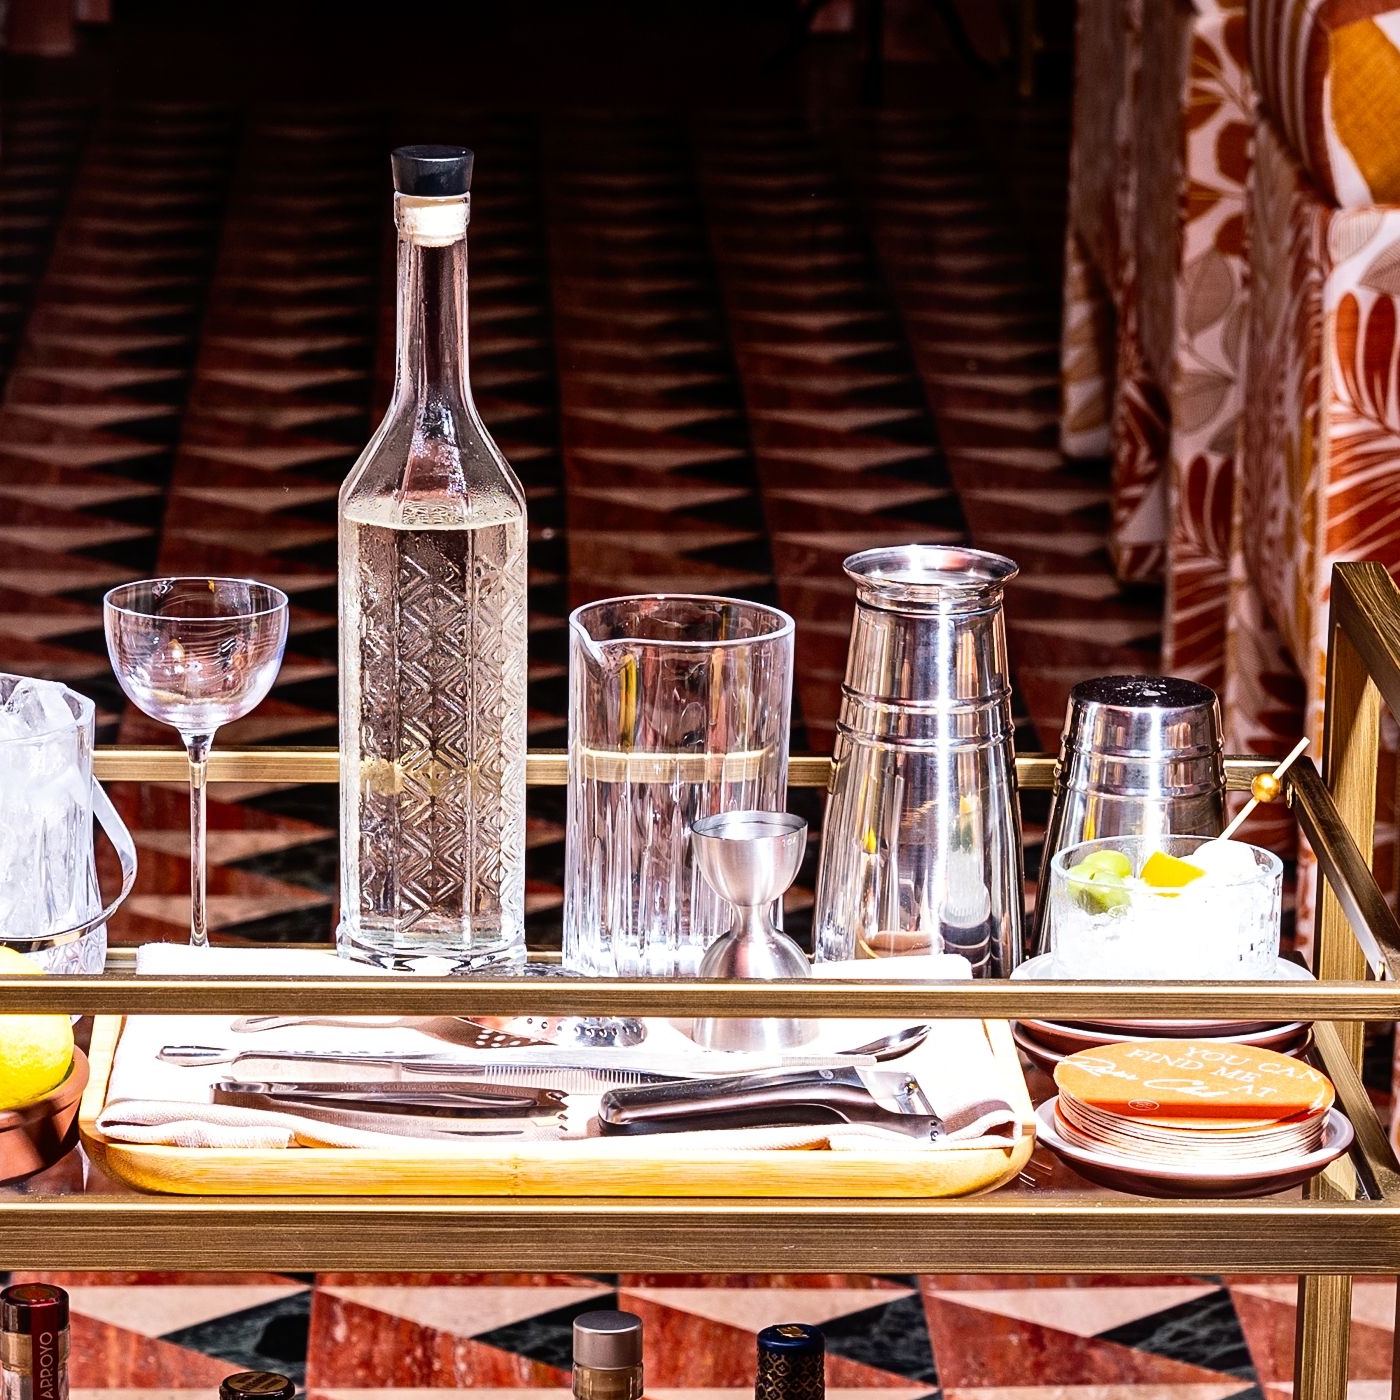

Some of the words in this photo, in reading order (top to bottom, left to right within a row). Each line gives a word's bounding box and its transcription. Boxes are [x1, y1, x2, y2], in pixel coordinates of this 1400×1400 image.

[1124, 1048, 1205, 1070] FIND
[1209, 1067, 1262, 1083] ME
[1183, 1046, 1250, 1066] YOU
[1258, 1062, 1321, 1083] CAN
[1230, 1084, 1278, 1098] AT
[39, 1331, 54, 1399] ARROYO
